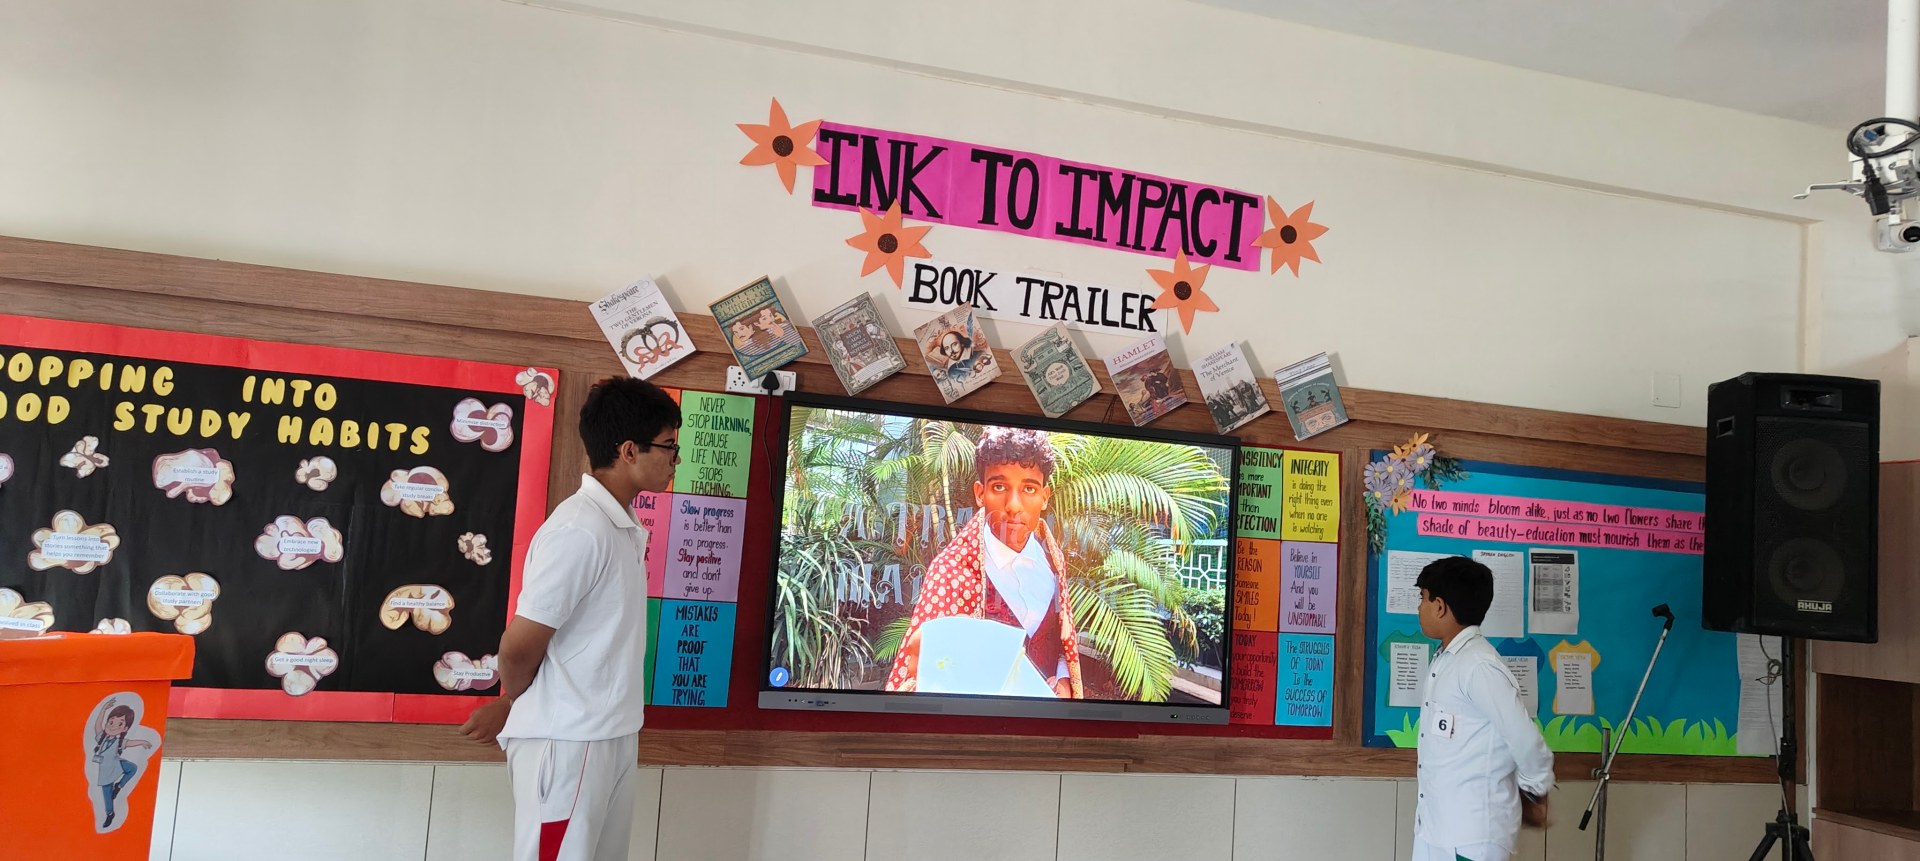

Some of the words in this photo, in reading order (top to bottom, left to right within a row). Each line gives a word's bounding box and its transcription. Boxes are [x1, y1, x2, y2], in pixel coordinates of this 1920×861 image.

[814, 128, 948, 218] INK
[971, 148, 1040, 230] TO
[1055, 164, 1259, 263] IMPACT
[908, 263, 997, 311] BOOK
[1015, 277, 1157, 333] TRAILER
[1113, 339, 1155, 365] HAMLET
[0, 352, 175, 397] OPPING
[242, 375, 337, 411] INTO
[700, 397, 726, 414] NEVER
[113, 401, 251, 440] STUDY
[277, 415, 431, 455] HABITS
[687, 413, 711, 429] STOP
[694, 431, 729, 449] BECAUSE
[690, 448, 709, 465] LIFE
[711, 450, 738, 468] NEVER
[698, 467, 723, 482] STOPS
[1291, 458, 1329, 477] INTEGRITY
[1248, 473, 1264, 481] more
[1292, 480, 1296, 489] is
[1299, 478, 1314, 494] doing
[1316, 480, 1326, 492] the
[1240, 499, 1259, 513] than
[1288, 492, 1302, 507] right
[1305, 493, 1319, 509] thing
[1320, 498, 1333, 507] even
[680, 500, 700, 515] Slow
[703, 507, 734, 520] progress
[1289, 507, 1305, 520] when
[1307, 512, 1314, 520] no
[1316, 512, 1328, 521] one
[1412, 493, 1427, 509] No
[1431, 494, 1447, 510] two
[1452, 499, 1480, 513] minds
[1488, 498, 1520, 516] bloom
[1553, 507, 1570, 521] just
[1572, 510, 1584, 521] as
[1586, 510, 1598, 523] no
[1603, 509, 1620, 524] two
[1625, 508, 1659, 527] flowers
[1665, 514, 1692, 530] share
[684, 520, 689, 531] is
[693, 518, 715, 533] better
[717, 519, 732, 534] than
[1293, 522, 1297, 532] is
[1422, 517, 1454, 533] shade
[1458, 520, 1470, 535] of
[1578, 528, 1601, 544] must
[1603, 532, 1640, 547] nourish
[1647, 532, 1670, 549] them
[1674, 539, 1685, 550] as
[683, 539, 693, 547] no
[677, 548, 694, 566] Stay
[696, 552, 722, 567] positive
[1290, 548, 1308, 563] Believe
[1311, 552, 1318, 563] in
[683, 564, 698, 579] and
[1237, 558, 1263, 572] REASON
[1294, 565, 1322, 580] YOURSELF
[683, 582, 699, 597] give
[1290, 580, 1304, 594] And
[1235, 590, 1260, 606] SMILES
[675, 605, 719, 622] MISTAKES
[1797, 601, 1832, 611] AHUJA
[1287, 610, 1327, 628] UNSTOPPABLE
[681, 624, 700, 637] ARE
[676, 640, 708, 655] PROOF
[1286, 641, 1297, 654] The
[1300, 641, 1330, 655] STRUGGLES
[678, 656, 701, 672] THAT
[1305, 657, 1324, 671] TODAY
[672, 674, 690, 687] YOU
[691, 674, 708, 688] ARE
[1285, 688, 1315, 702] SUCCESS
[1287, 703, 1323, 718] TOMORROW
[1438, 719, 1447, 731] 6
